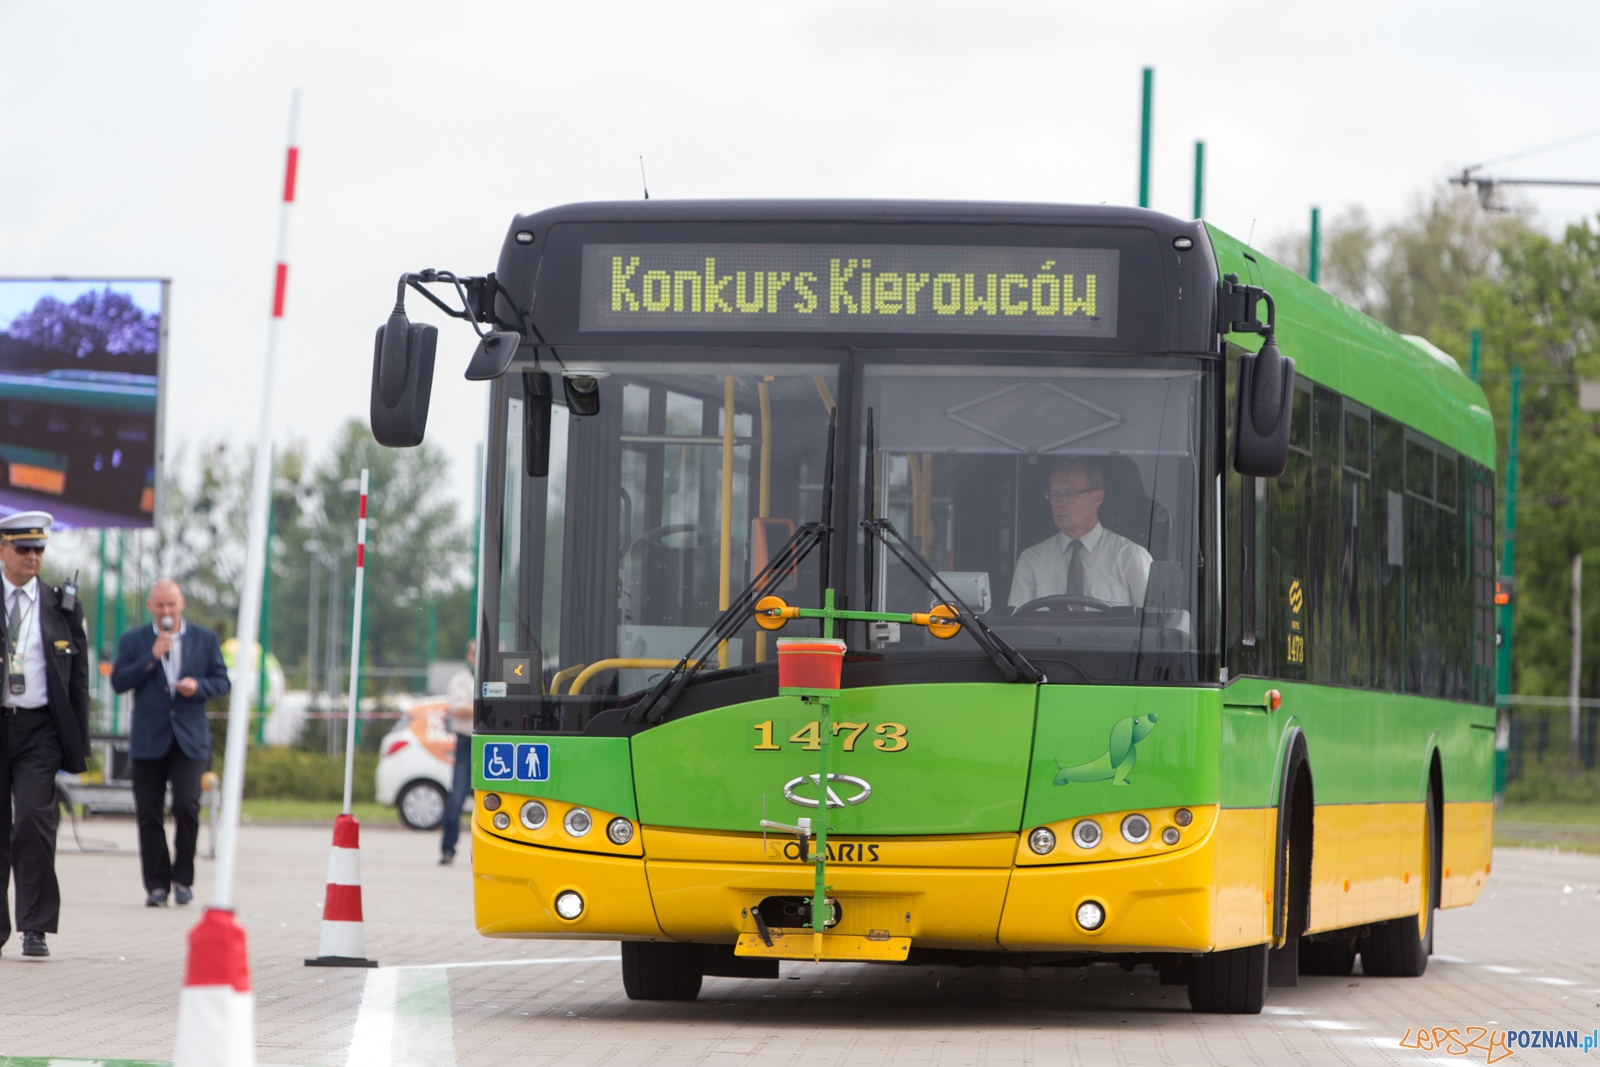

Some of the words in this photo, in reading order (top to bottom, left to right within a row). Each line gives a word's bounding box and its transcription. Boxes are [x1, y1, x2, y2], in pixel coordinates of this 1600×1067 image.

[611, 256, 819, 315] Konkurs
[829, 258, 1097, 316] Kierowców
[1287, 634, 1304, 663] 1473
[753, 720, 909, 752] 1473
[769, 841, 880, 862] SOARIS
